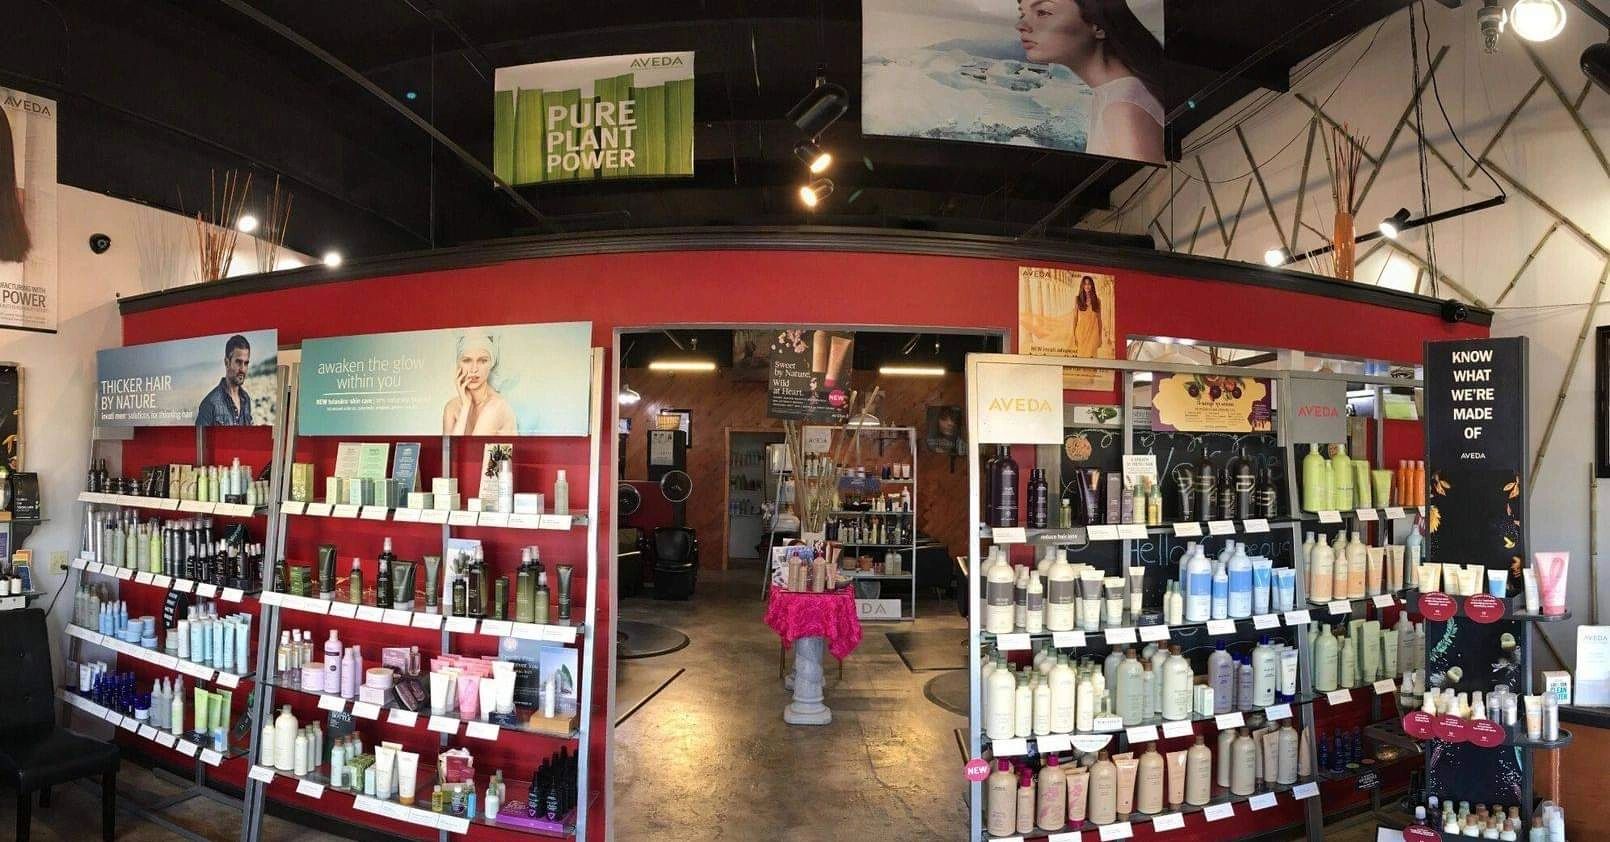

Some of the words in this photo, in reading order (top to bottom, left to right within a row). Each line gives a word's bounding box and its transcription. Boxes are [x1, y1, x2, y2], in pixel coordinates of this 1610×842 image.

[630, 56, 683, 68] AVEDA
[4, 96, 51, 116] AVEDA
[548, 100, 636, 130] PURE
[547, 125, 637, 152] PLANT
[547, 150, 636, 173] POWER
[3, 290, 46, 308] POWER
[1452, 350, 1493, 364] KNOW
[318, 358, 364, 374] awaken
[368, 357, 390, 372] the
[393, 356, 425, 376] glow
[775, 361, 796, 369] Sweet
[774, 368, 783, 377] by
[1454, 369, 1492, 382] WHAT
[101, 378, 142, 394] THICKER
[146, 375, 172, 391] HAIR
[337, 374, 374, 389] within
[377, 375, 401, 391] you
[773, 379, 790, 387] Wild
[101, 396, 113, 410] BY
[116, 393, 156, 409] NATURE
[1451, 388, 1494, 401] WE'RE
[989, 398, 1052, 412] AVEDA
[1298, 406, 1339, 417] AVEDA
[1453, 408, 1493, 420] MADE
[1464, 427, 1482, 439] OF
[968, 766, 988, 775] NEW
